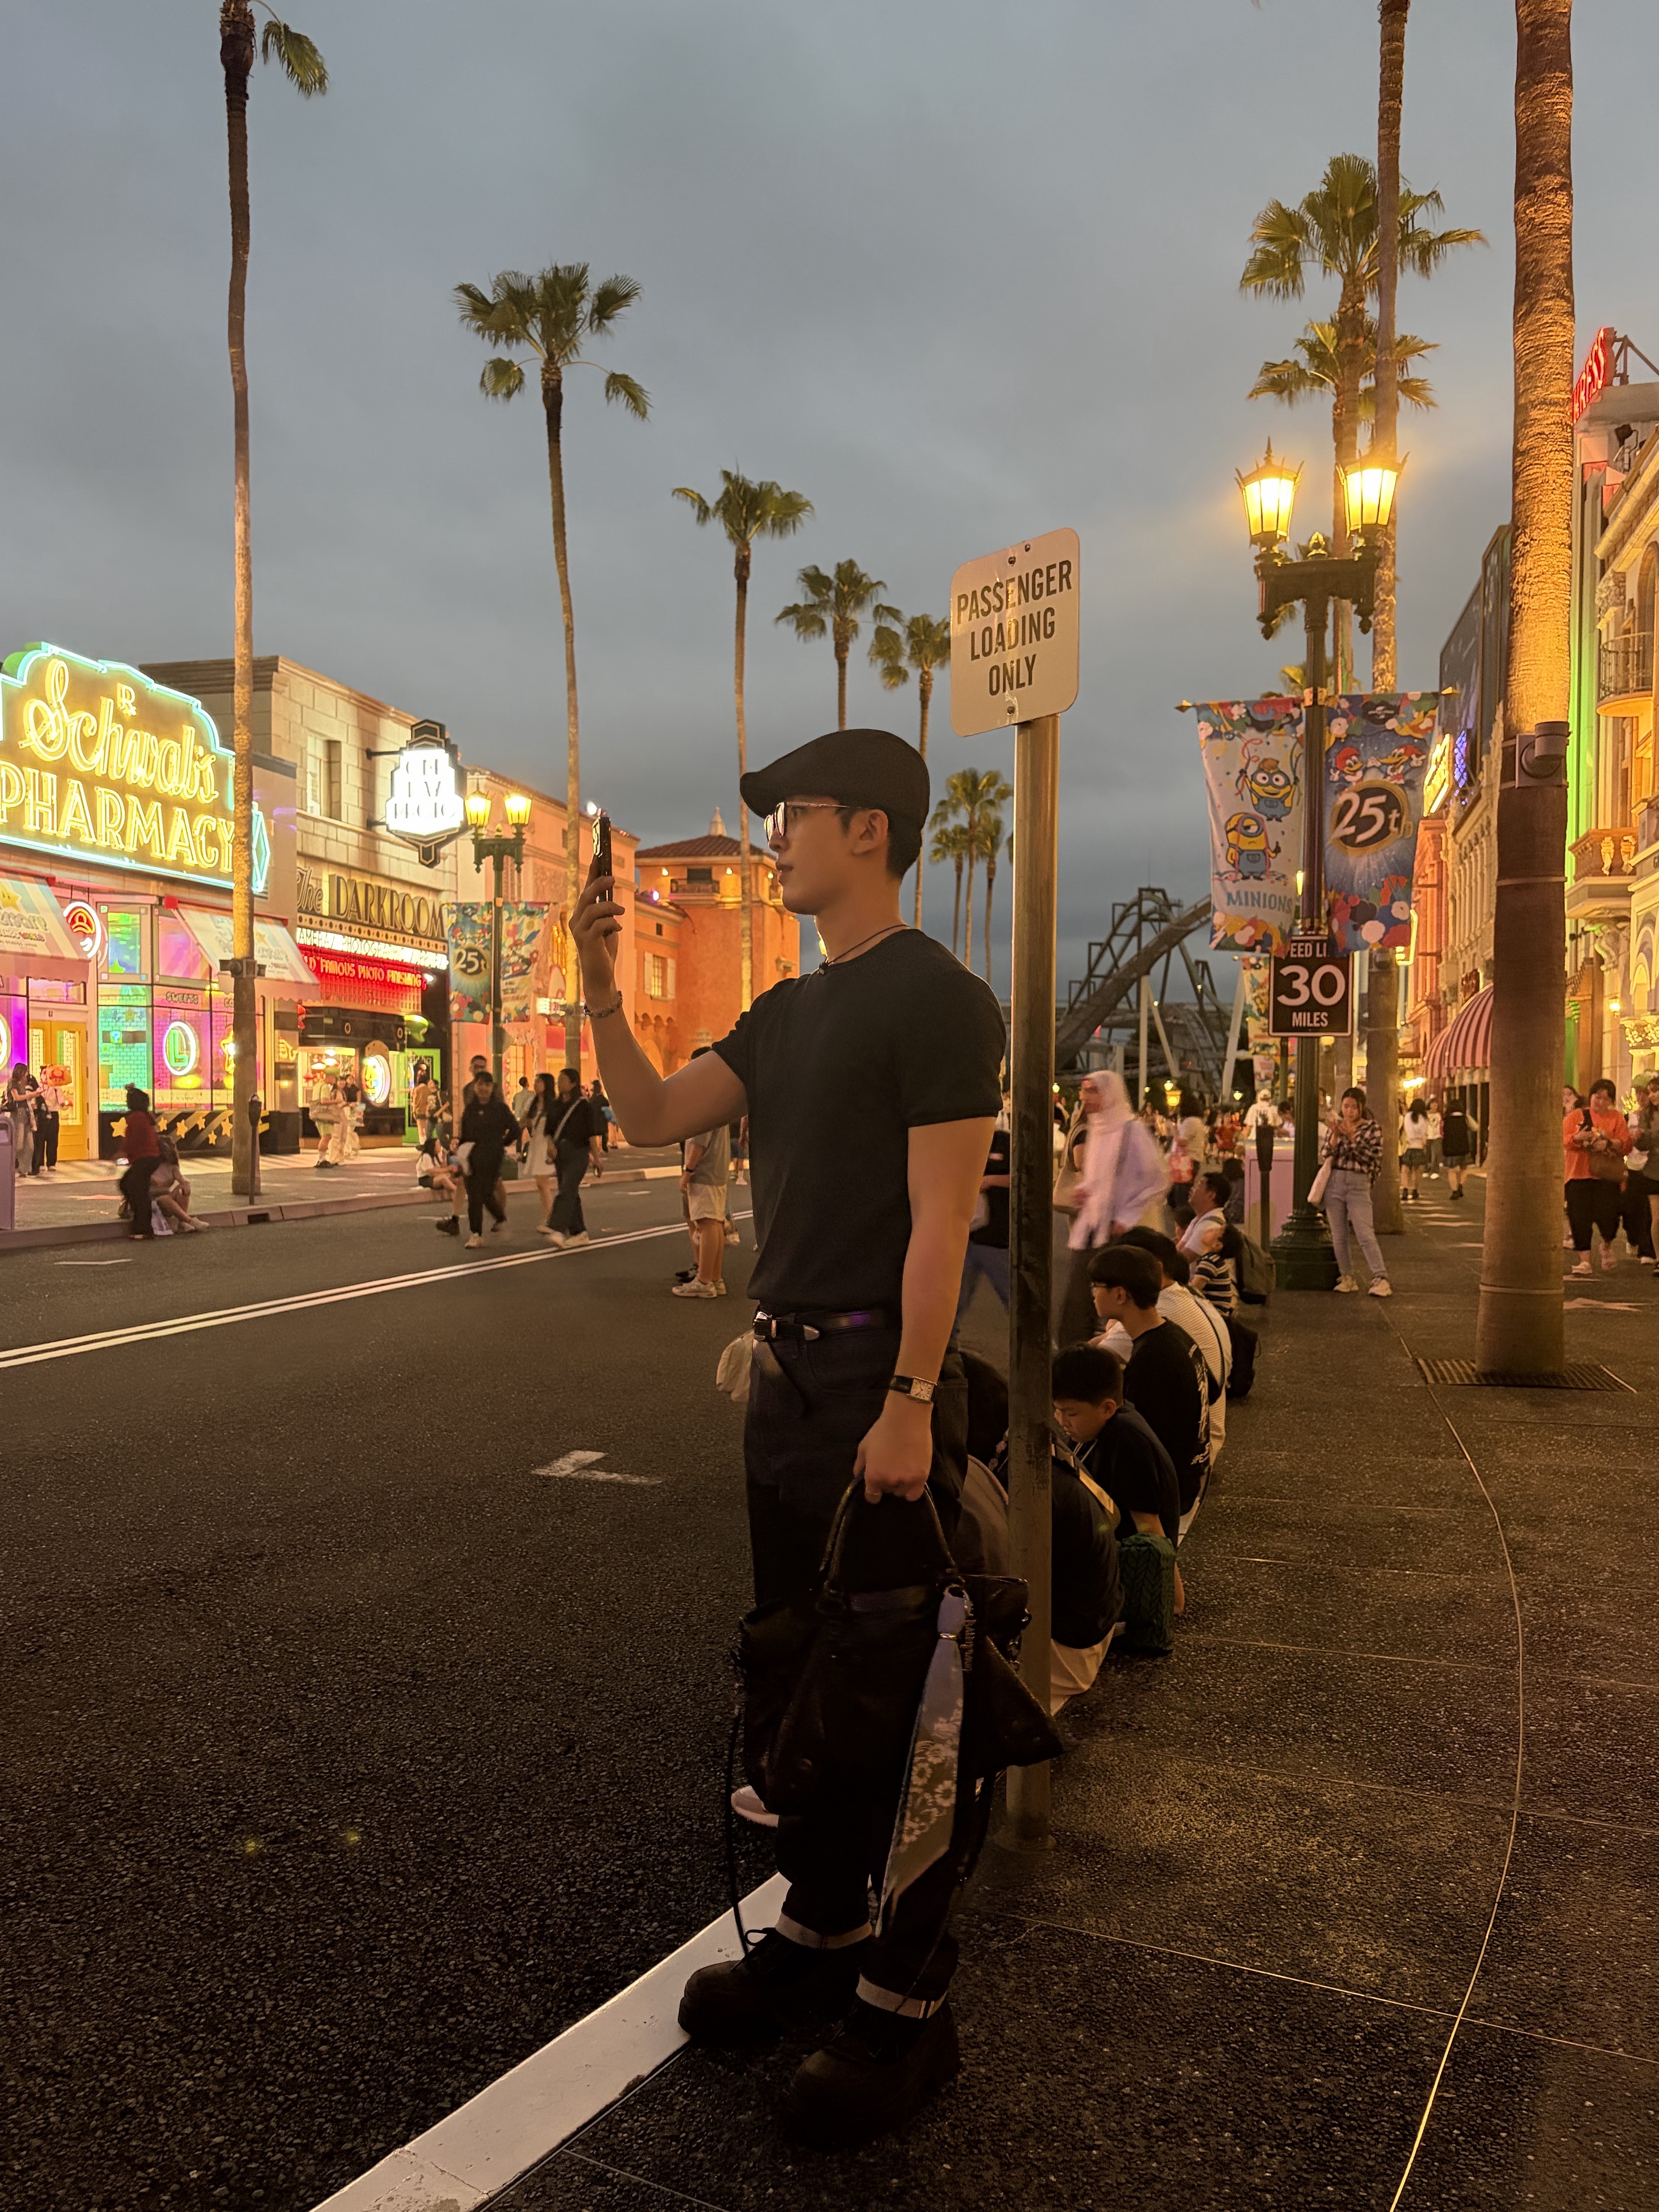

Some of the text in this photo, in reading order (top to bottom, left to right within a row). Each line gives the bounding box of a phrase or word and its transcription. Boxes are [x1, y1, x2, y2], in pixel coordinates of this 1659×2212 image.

[957, 560, 1072, 625] PASSENGER
[971, 607, 1055, 661] LOADING
[989, 654, 1036, 696] ONLY
[19, 659, 219, 804] Schwab's
[0, 760, 235, 872] PHARMACY
[297, 867, 446, 938] The DARKROOM
[1226, 890, 1293, 914] MINIONS
[320, 957, 356, 977] FAMOUS
[358, 965, 385, 981] PHOTO
[1290, 942, 1313, 958] EED
[166, 991, 198, 1004] SWEETS
[1277, 964, 1346, 1006] 30
[1292, 1012, 1328, 1028] MILES
[168, 1029, 188, 1067] L
